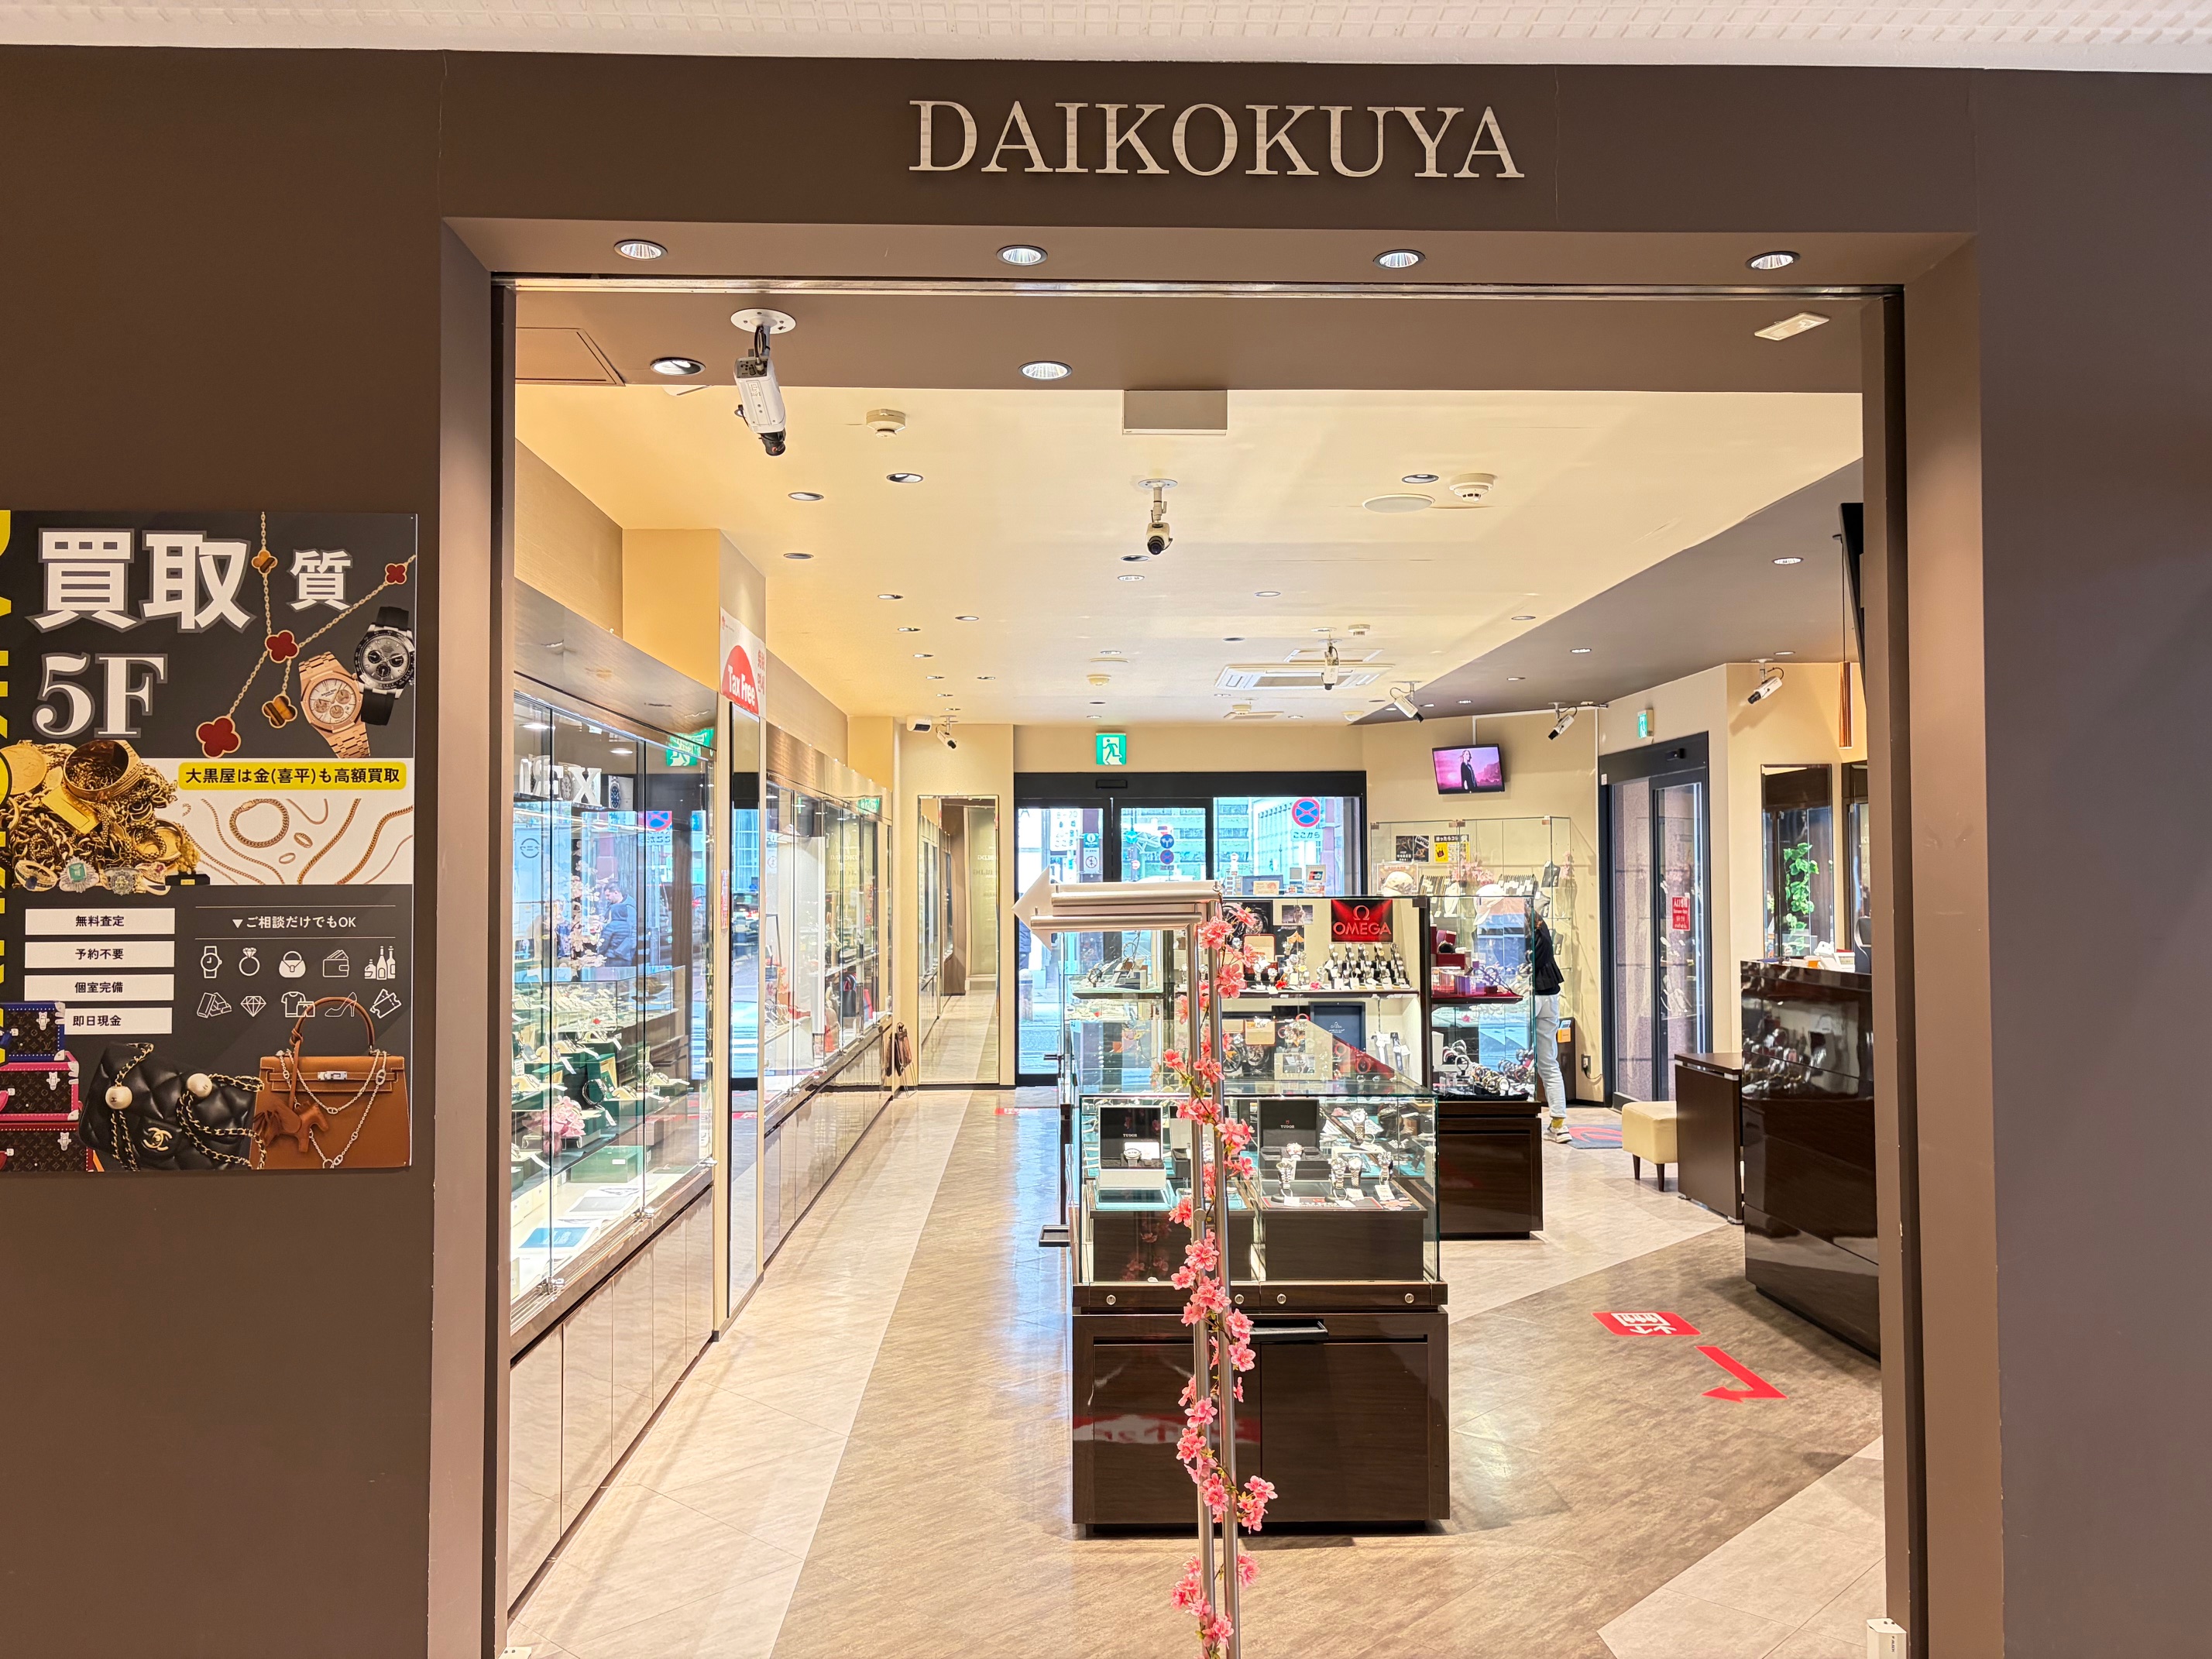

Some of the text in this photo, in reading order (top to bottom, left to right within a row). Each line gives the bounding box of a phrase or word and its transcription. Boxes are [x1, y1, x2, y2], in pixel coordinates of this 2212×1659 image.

[908, 99, 1525, 178] DAIKOKUYA
[31, 530, 254, 631] 買取
[290, 549, 353, 610] 質
[728, 664, 756, 706] Tax Free
[35, 655, 167, 737] 5F
[185, 768, 400, 785] 大黒屋は金(喜平)も高額買取
[75, 915, 125, 927] 無料査定
[246, 915, 357, 929] ご相談だけでもOK
[1333, 921, 1392, 936] OMEGA
[75, 948, 125, 960] 予約不要
[74, 981, 124, 994] 個室完備
[73, 1014, 122, 1027] 即日現金
